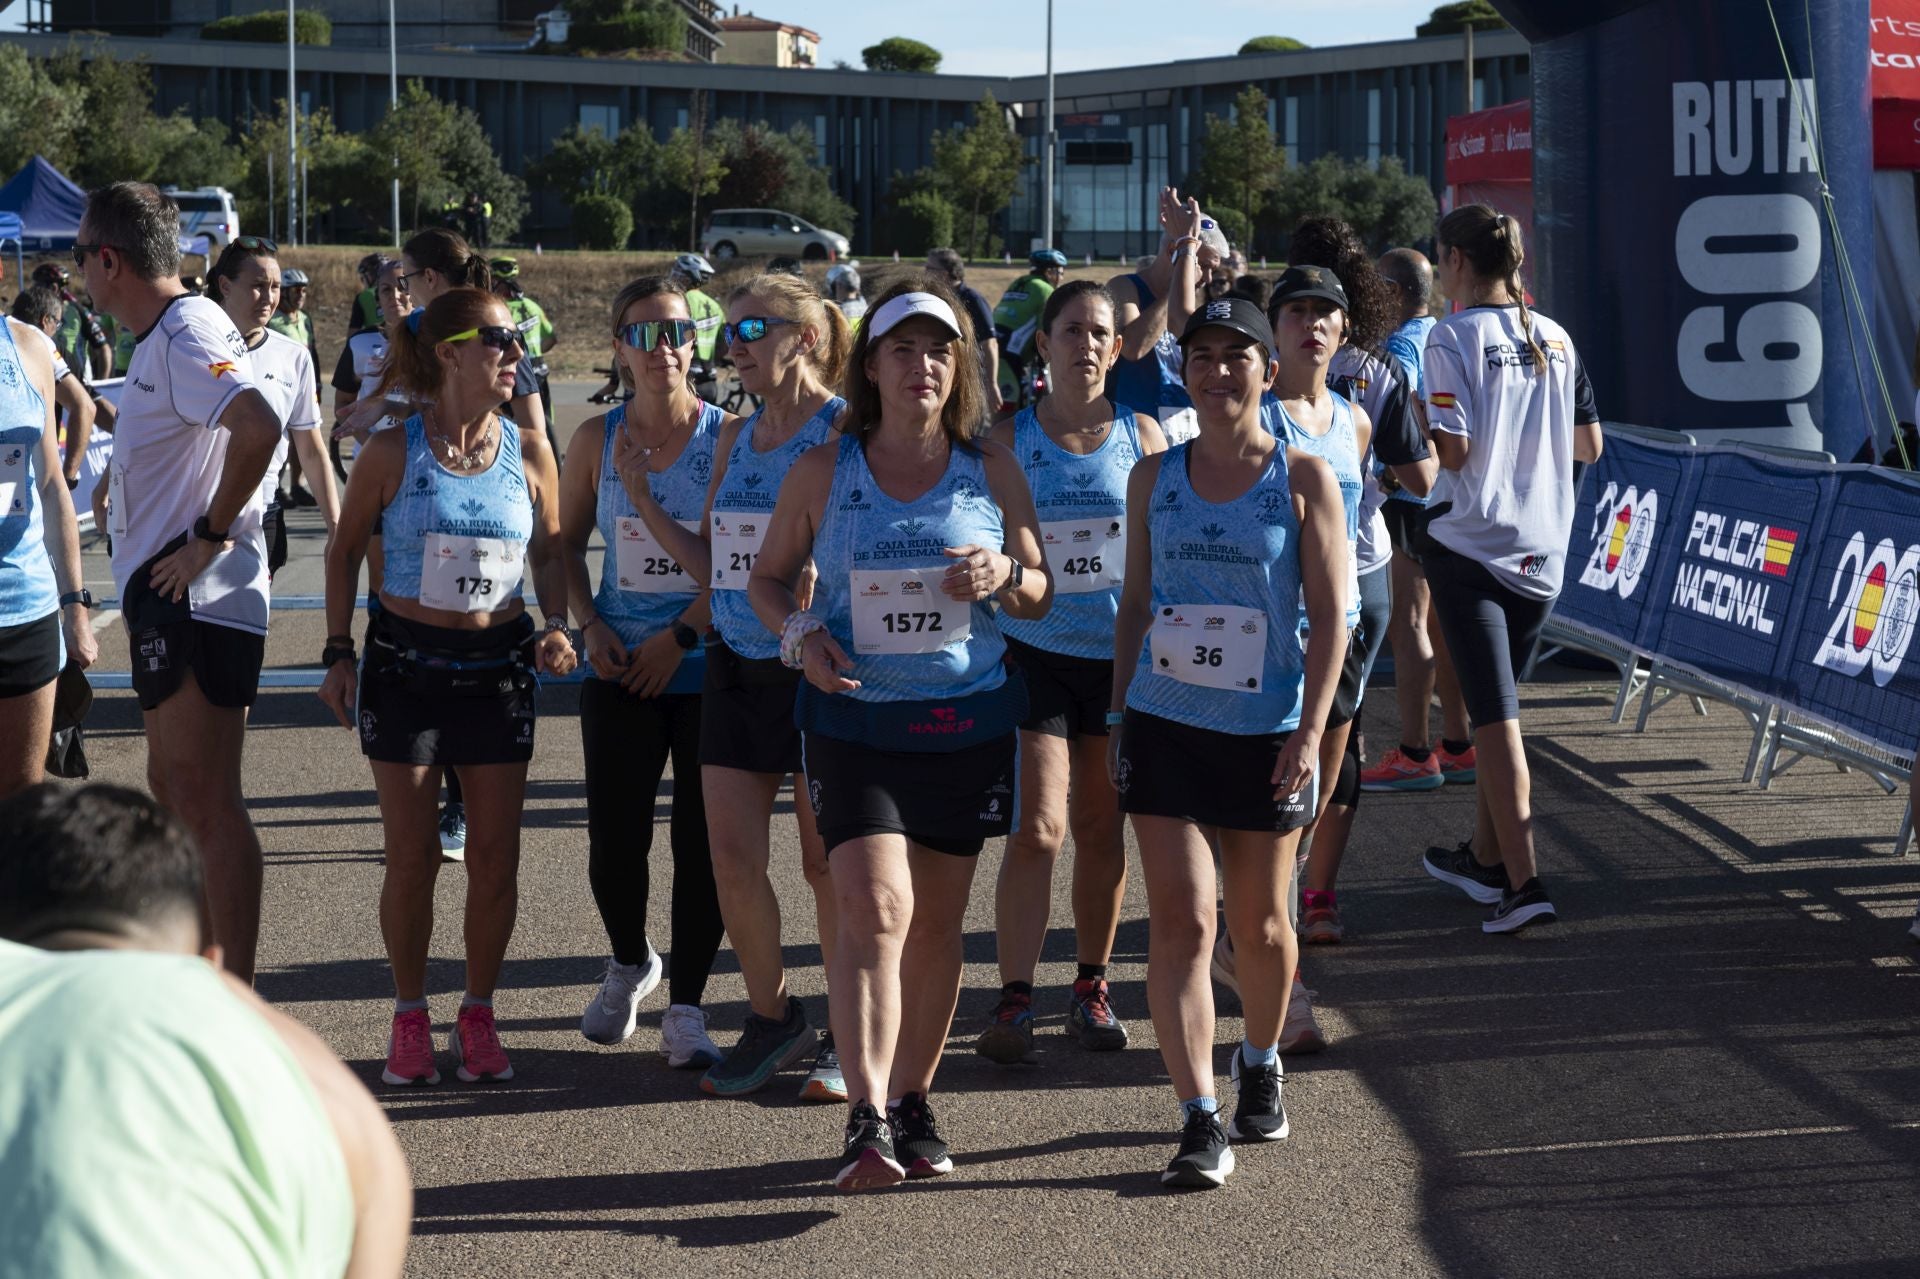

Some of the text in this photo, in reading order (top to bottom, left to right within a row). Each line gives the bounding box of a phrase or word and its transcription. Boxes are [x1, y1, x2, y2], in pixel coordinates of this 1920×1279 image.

[1871, 48, 1920, 68] ta
[1672, 78, 1820, 177] RUTA
[1484, 340, 1550, 358] POLICA
[1024, 460, 1051, 470] VIATOR
[405, 489, 439, 498] VIATOR
[725, 491, 772, 501] CAJA RURAL
[1080, 490, 1114, 498] RURAL
[839, 503, 871, 512] VIATOR
[1036, 501, 1049, 509] DE
[1155, 504, 1183, 513] VIATOR
[439, 520, 507, 530] CAJA RURAL
[876, 538, 949, 550] CAJA RURAL
[1579, 481, 1658, 600] 200
[853, 551, 870, 562] DE
[1180, 543, 1242, 556] CAJA RURAL
[1063, 555, 1103, 576] 426
[1164, 551, 1261, 566] DE EXTREMADURA
[643, 557, 683, 576] 254
[456, 576, 493, 595] 173
[1672, 561, 1775, 635] NACIONAL
[1812, 530, 1920, 687] 200
[881, 611, 943, 633] 1572
[1192, 645, 1223, 667] 36
[908, 719, 974, 734] HANKER
[1277, 804, 1305, 812] VIATOR
